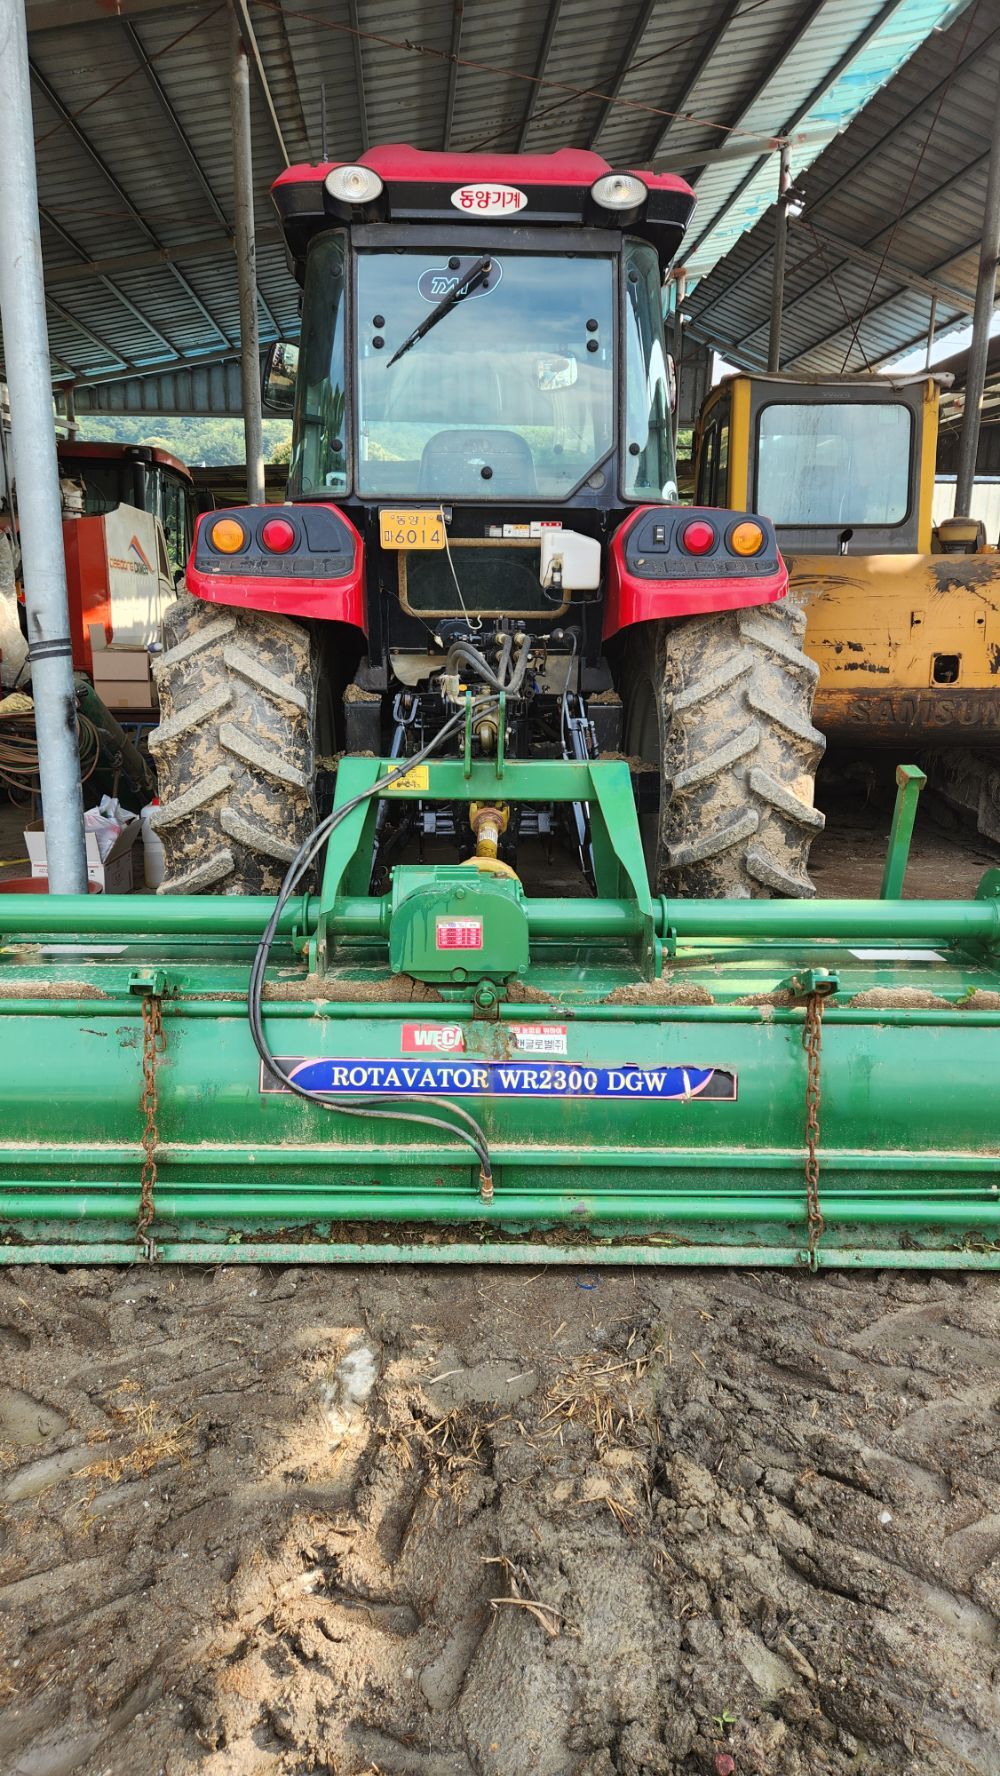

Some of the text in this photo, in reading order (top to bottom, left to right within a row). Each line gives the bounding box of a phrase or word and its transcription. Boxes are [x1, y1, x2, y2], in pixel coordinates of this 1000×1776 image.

[460, 190, 520, 209] 동양기계
[331, 1066, 668, 1092] ROTAVATOR WR2300 DGW
